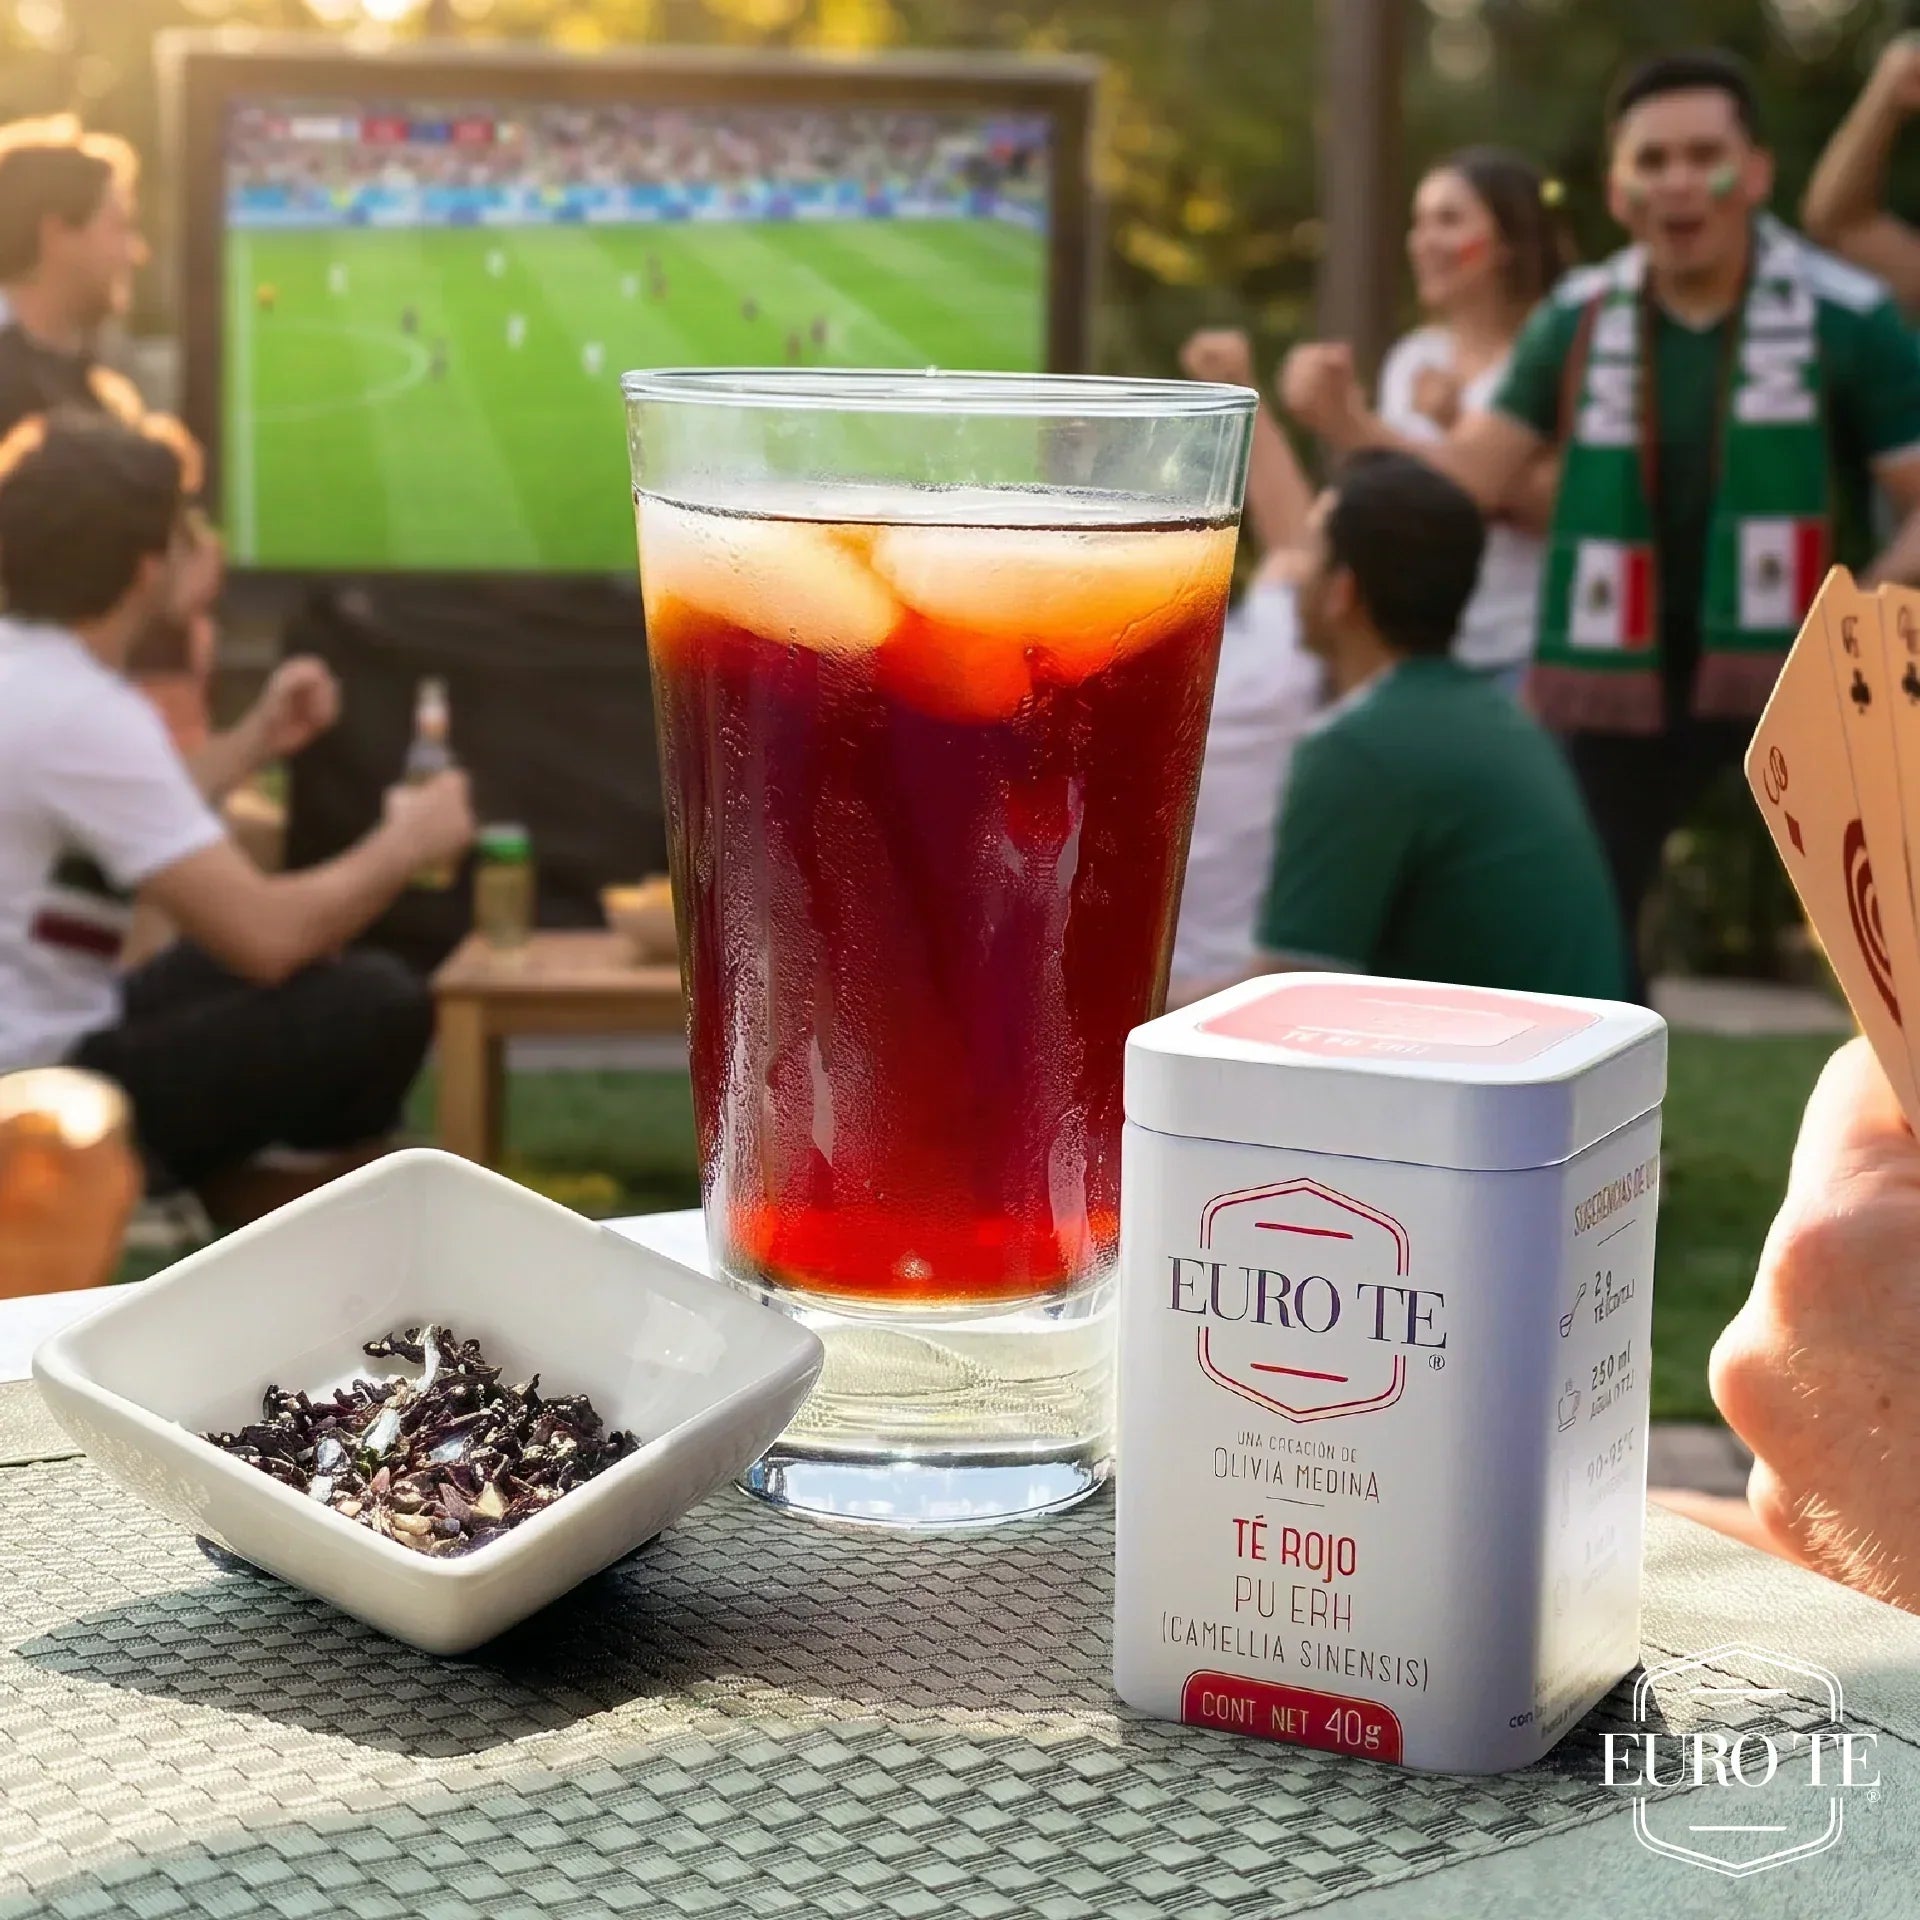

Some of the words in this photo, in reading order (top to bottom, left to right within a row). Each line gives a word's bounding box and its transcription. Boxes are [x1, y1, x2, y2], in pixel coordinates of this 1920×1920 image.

[1166, 1255, 1341, 1333] EURO
[1357, 1283, 1447, 1349] TE
[1594, 1270, 1601, 1297] 2
[1591, 1354, 1614, 1391] 250
[1618, 1339, 1631, 1371] ml
[1214, 1447, 1283, 1485] OLIVIA
[1296, 1464, 1380, 1504] MEDINA
[1237, 1431, 1262, 1448] UNA
[1341, 1447, 1357, 1463] DE
[1232, 1514, 1268, 1561] TÉ
[1281, 1526, 1357, 1583] ROJO
[1235, 1575, 1275, 1618] PU
[1291, 1585, 1351, 1633] ERH
[1162, 1611, 1285, 1663] (CAMELLIA
[1300, 1640, 1429, 1692] SINENSIS)
[1202, 1691, 1257, 1725] CONT
[1272, 1703, 1310, 1735] NET
[1324, 1707, 1383, 1750] 40g
